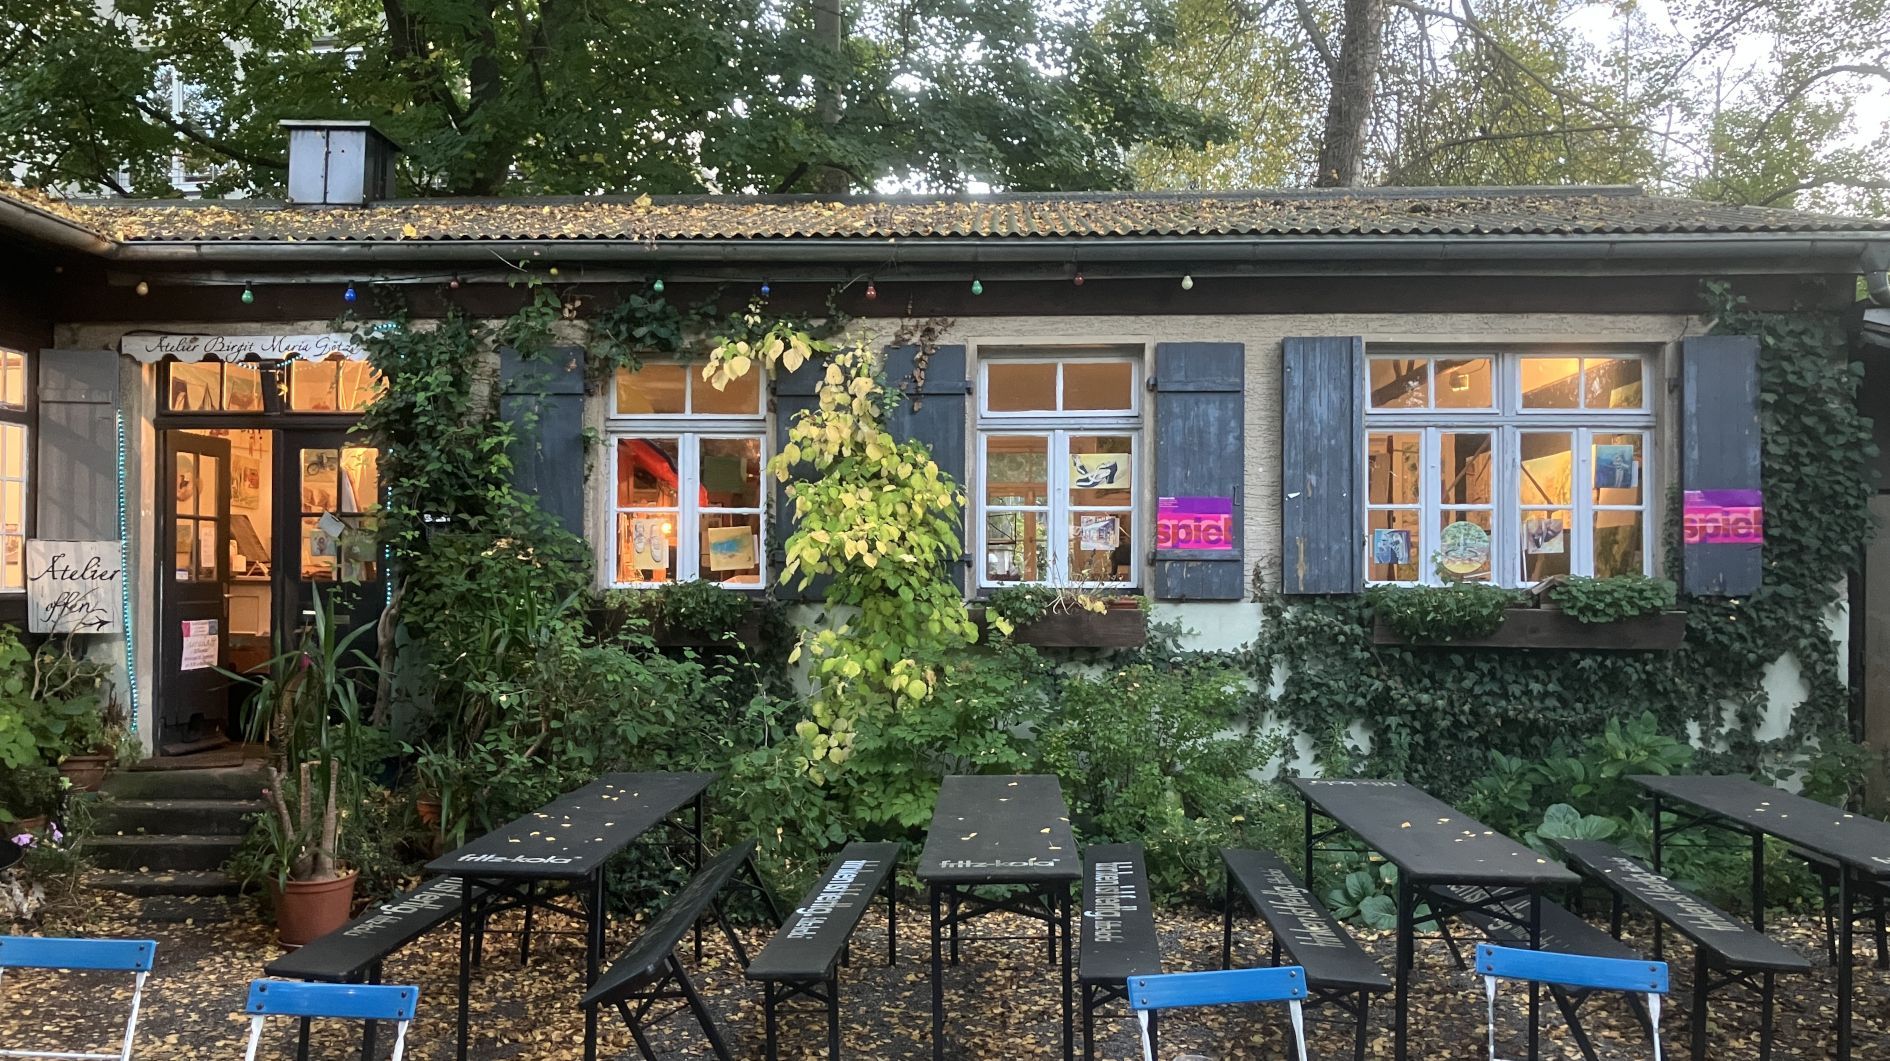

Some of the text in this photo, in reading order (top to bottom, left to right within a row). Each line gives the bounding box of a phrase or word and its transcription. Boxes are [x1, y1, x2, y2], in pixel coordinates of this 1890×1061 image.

[145, 336, 199, 353] Atelier
[204, 336, 254, 363] Birgit
[261, 335, 311, 353] Maria
[1157, 515, 1233, 549] spiel
[1684, 510, 1763, 544] spiel
[29, 553, 121, 582] Atelier
[40, 591, 107, 623] offen
[457, 853, 573, 864] fritz-kola
[939, 857, 1055, 868] fritz-kola
